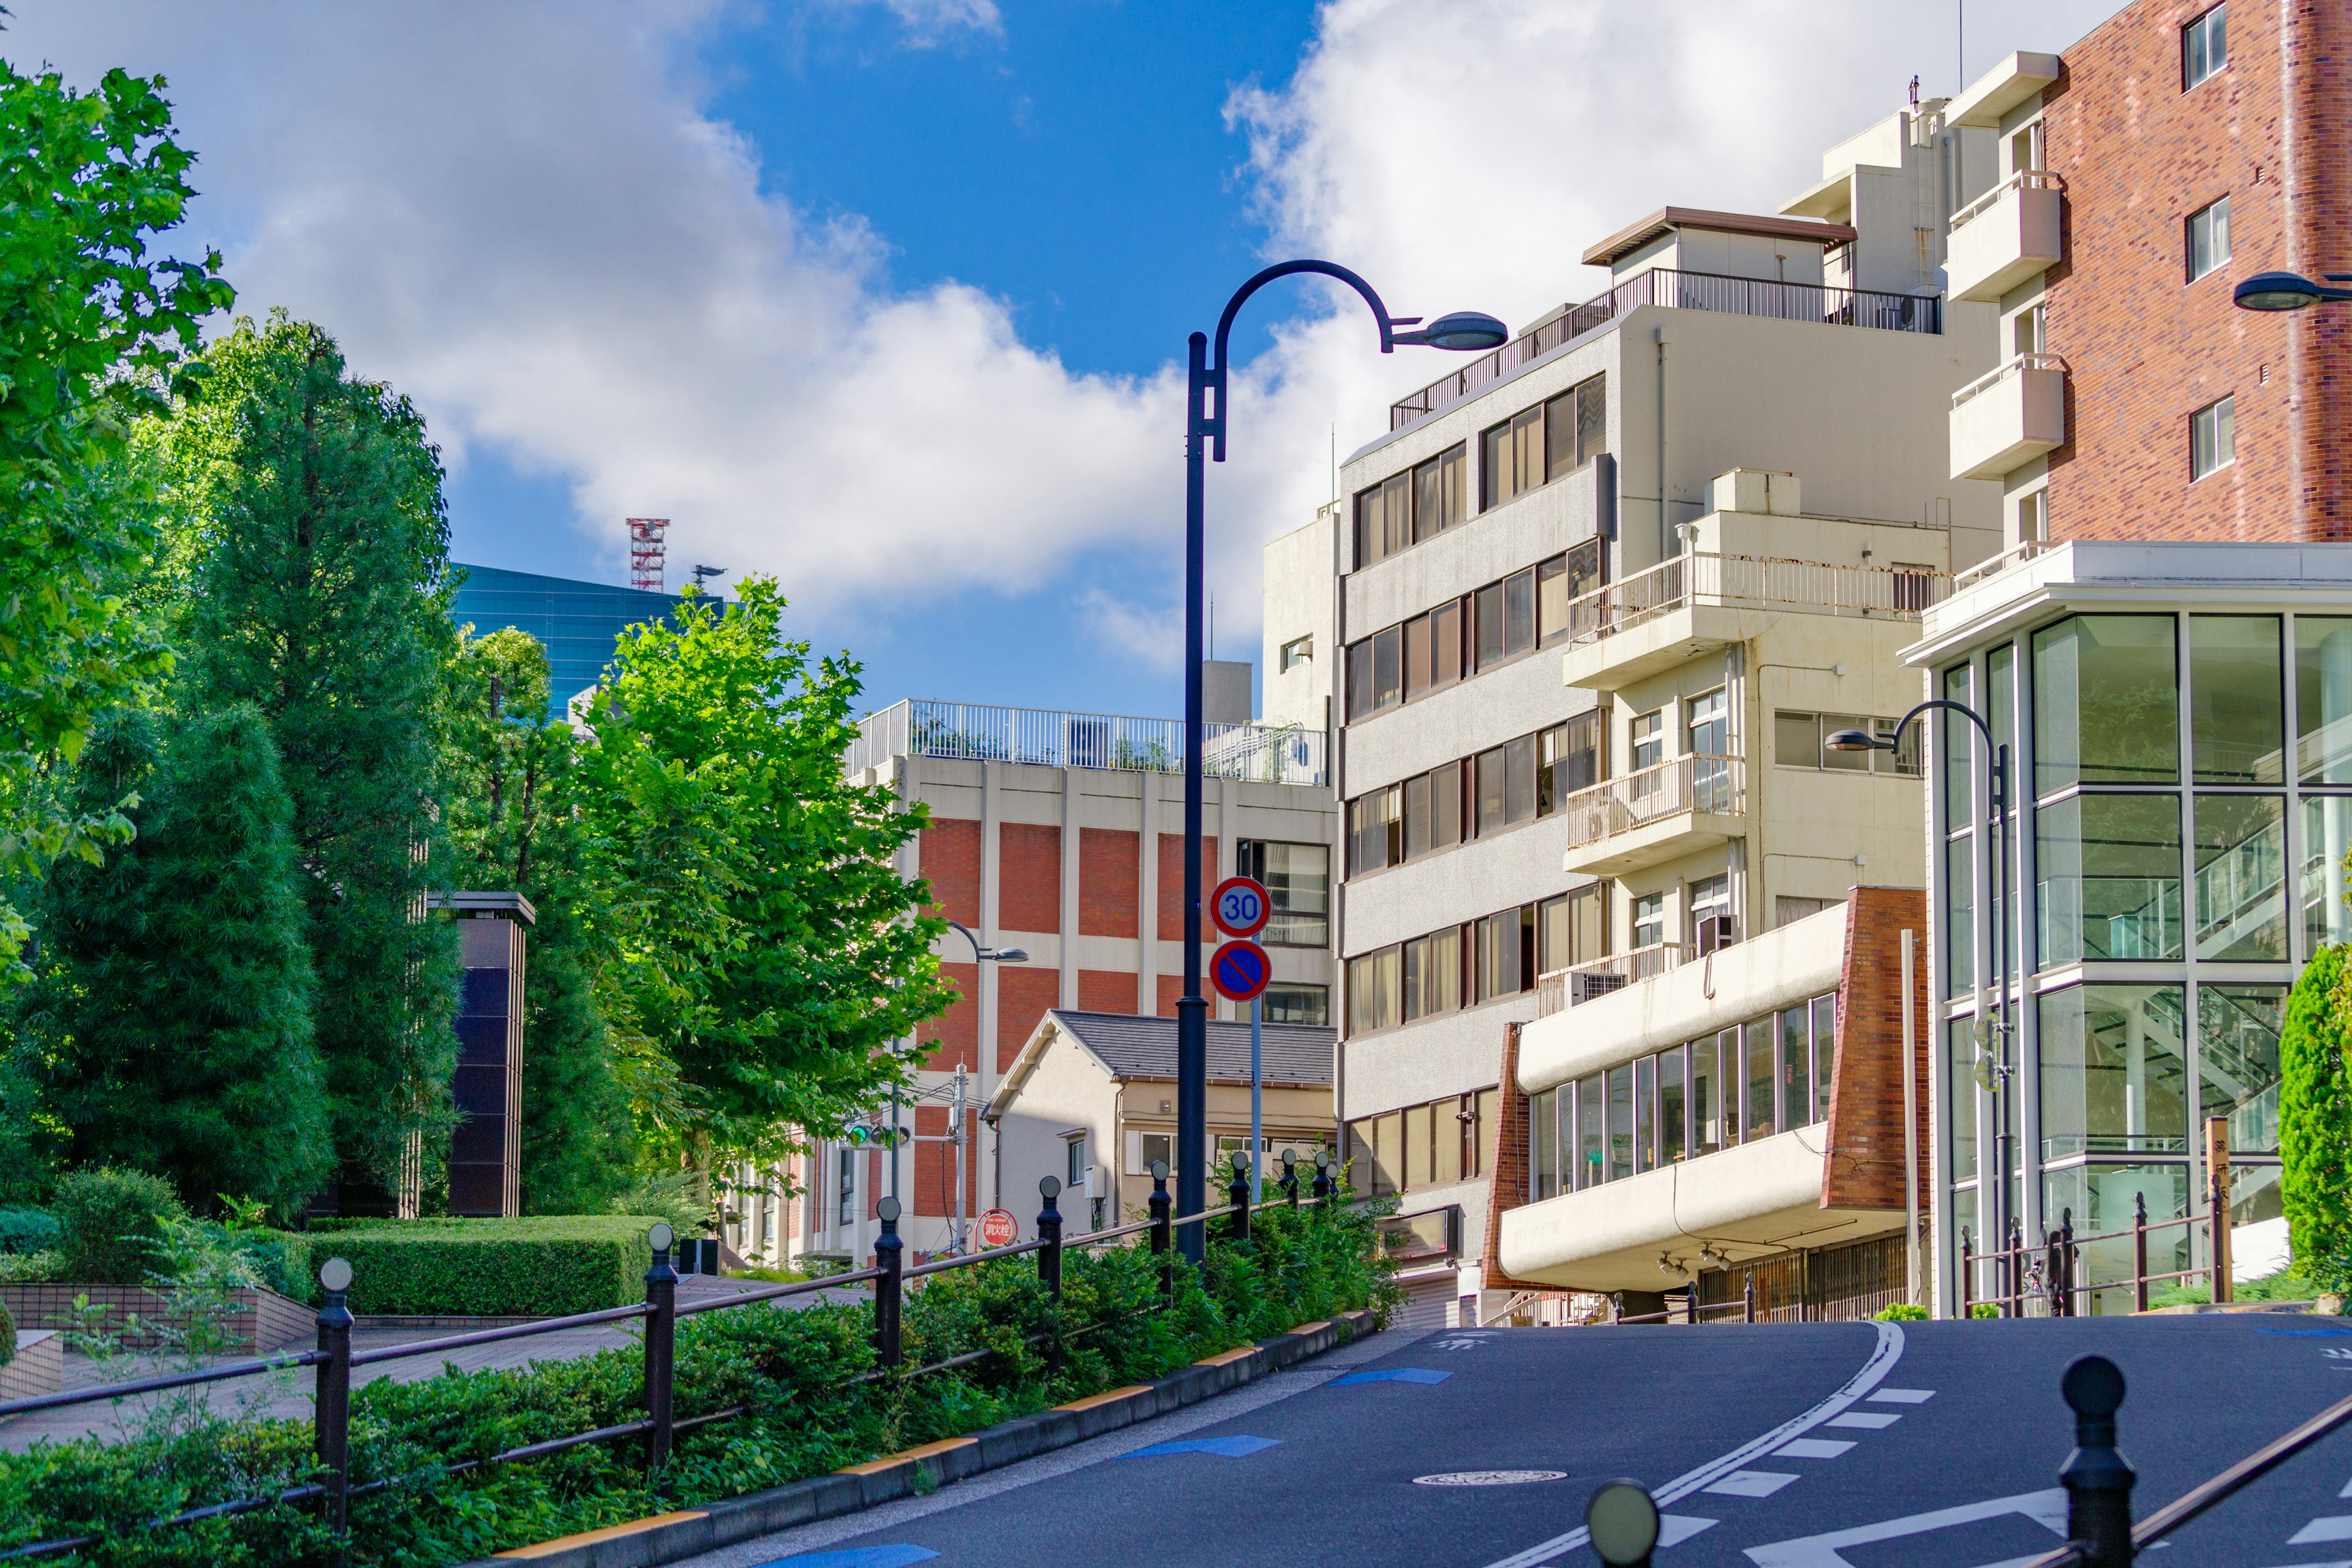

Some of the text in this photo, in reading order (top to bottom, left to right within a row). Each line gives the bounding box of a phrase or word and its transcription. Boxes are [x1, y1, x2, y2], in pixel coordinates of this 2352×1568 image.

[1224, 894, 1257, 921] 30
[985, 1223, 1010, 1237] 消火栓
